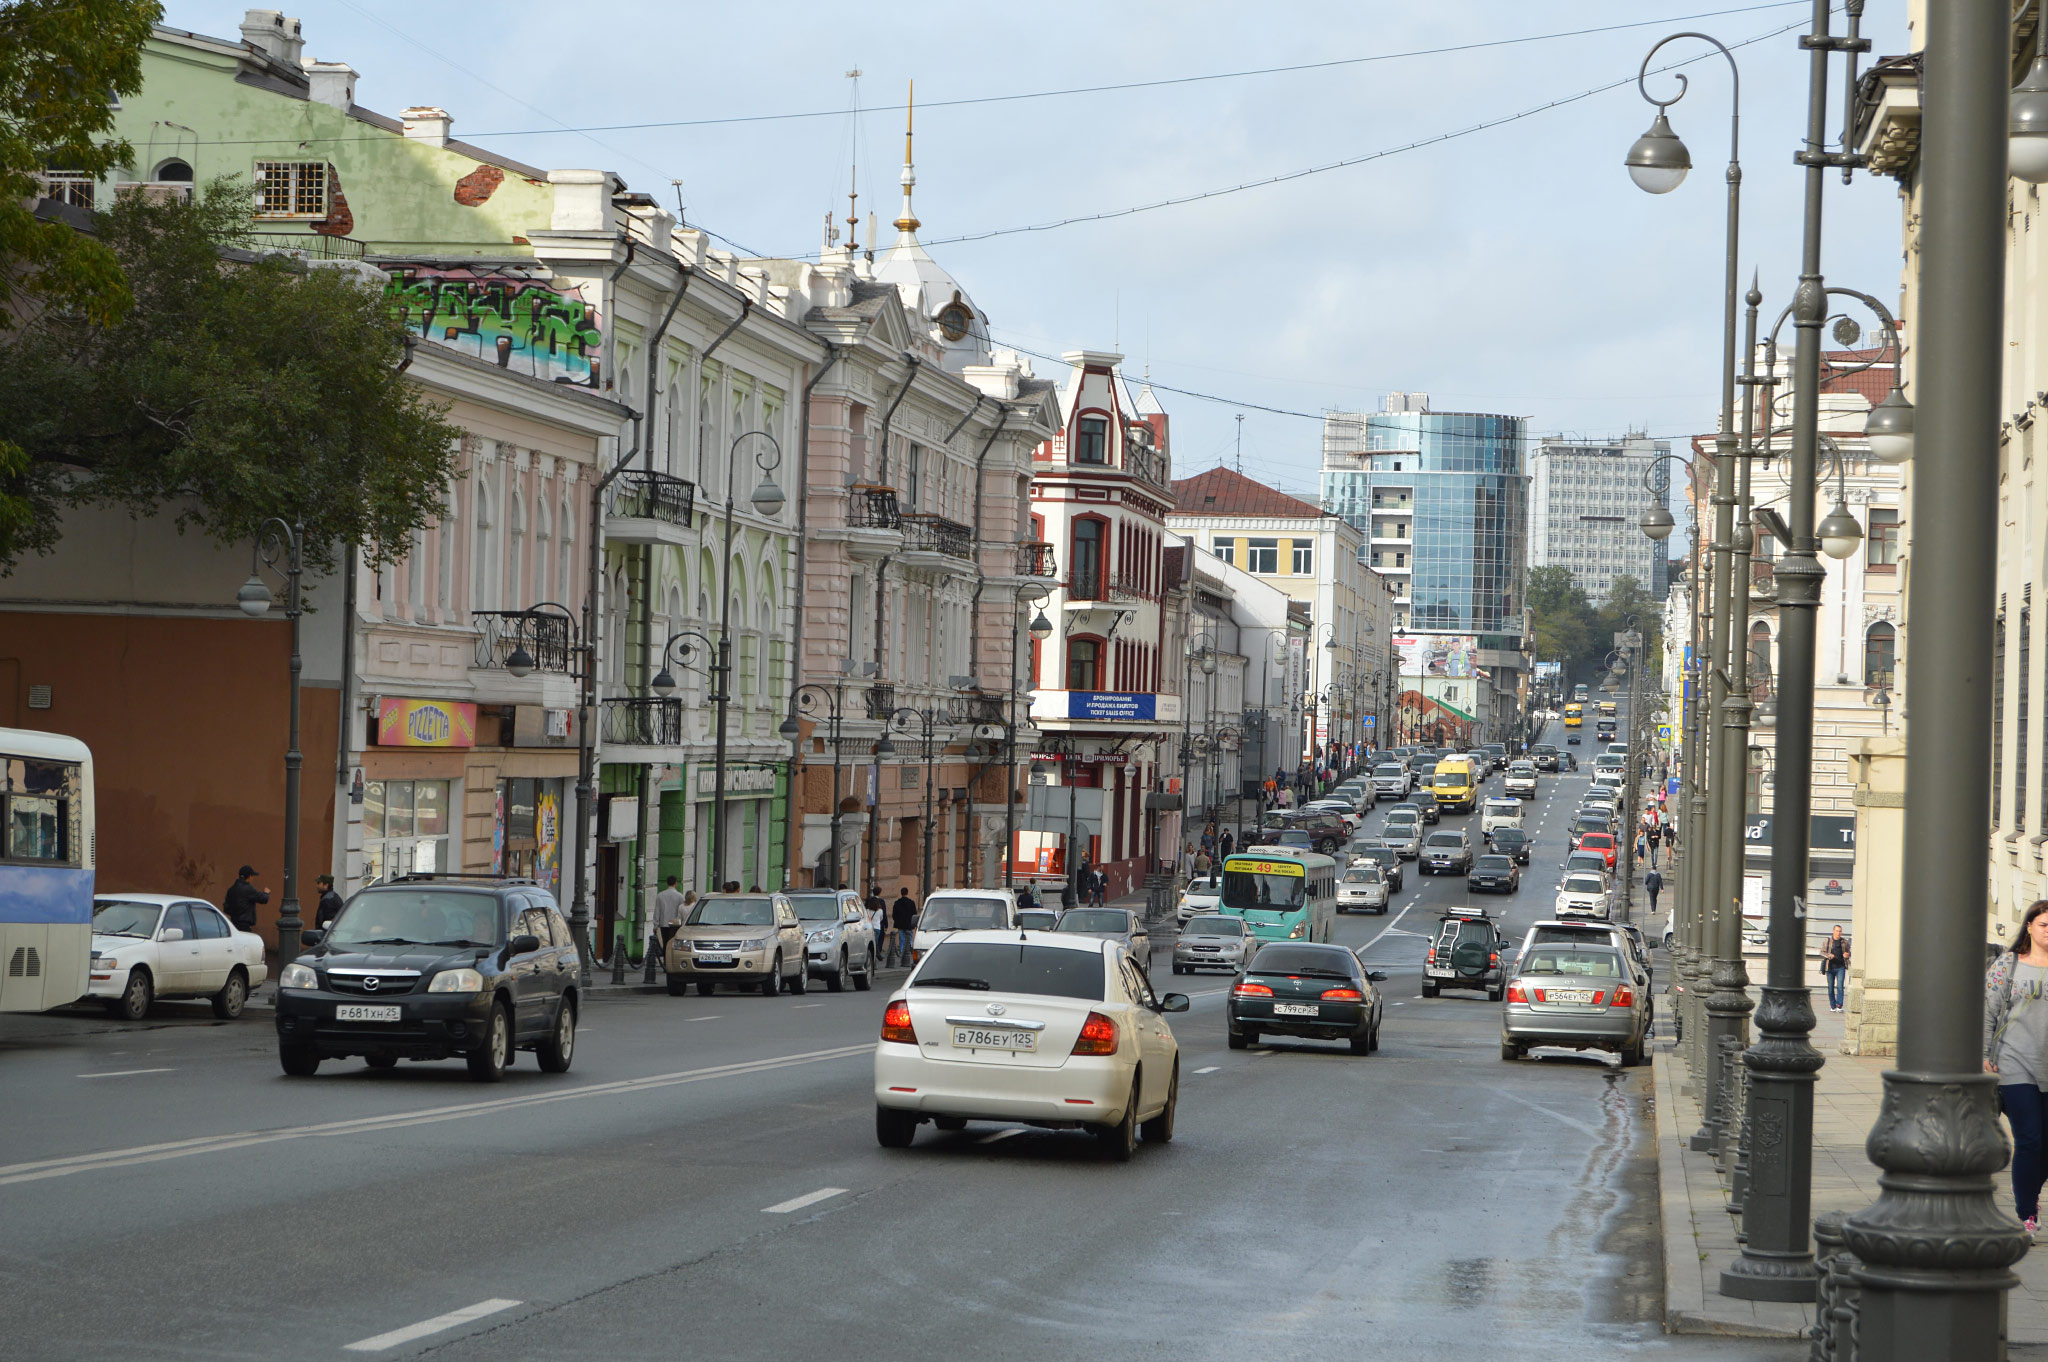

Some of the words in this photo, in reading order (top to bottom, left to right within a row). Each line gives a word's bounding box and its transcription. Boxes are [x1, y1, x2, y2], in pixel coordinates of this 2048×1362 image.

[407, 704, 450, 743] PIZZETTA
[1256, 863, 1272, 873] 49
[341, 1007, 383, 1018] Р681ХН
[386, 1007, 397, 1017] 25
[1277, 1005, 1307, 1014] С799СР
[958, 1030, 1009, 1046] В786ЕУ
[1012, 1033, 1031, 1044] 125
